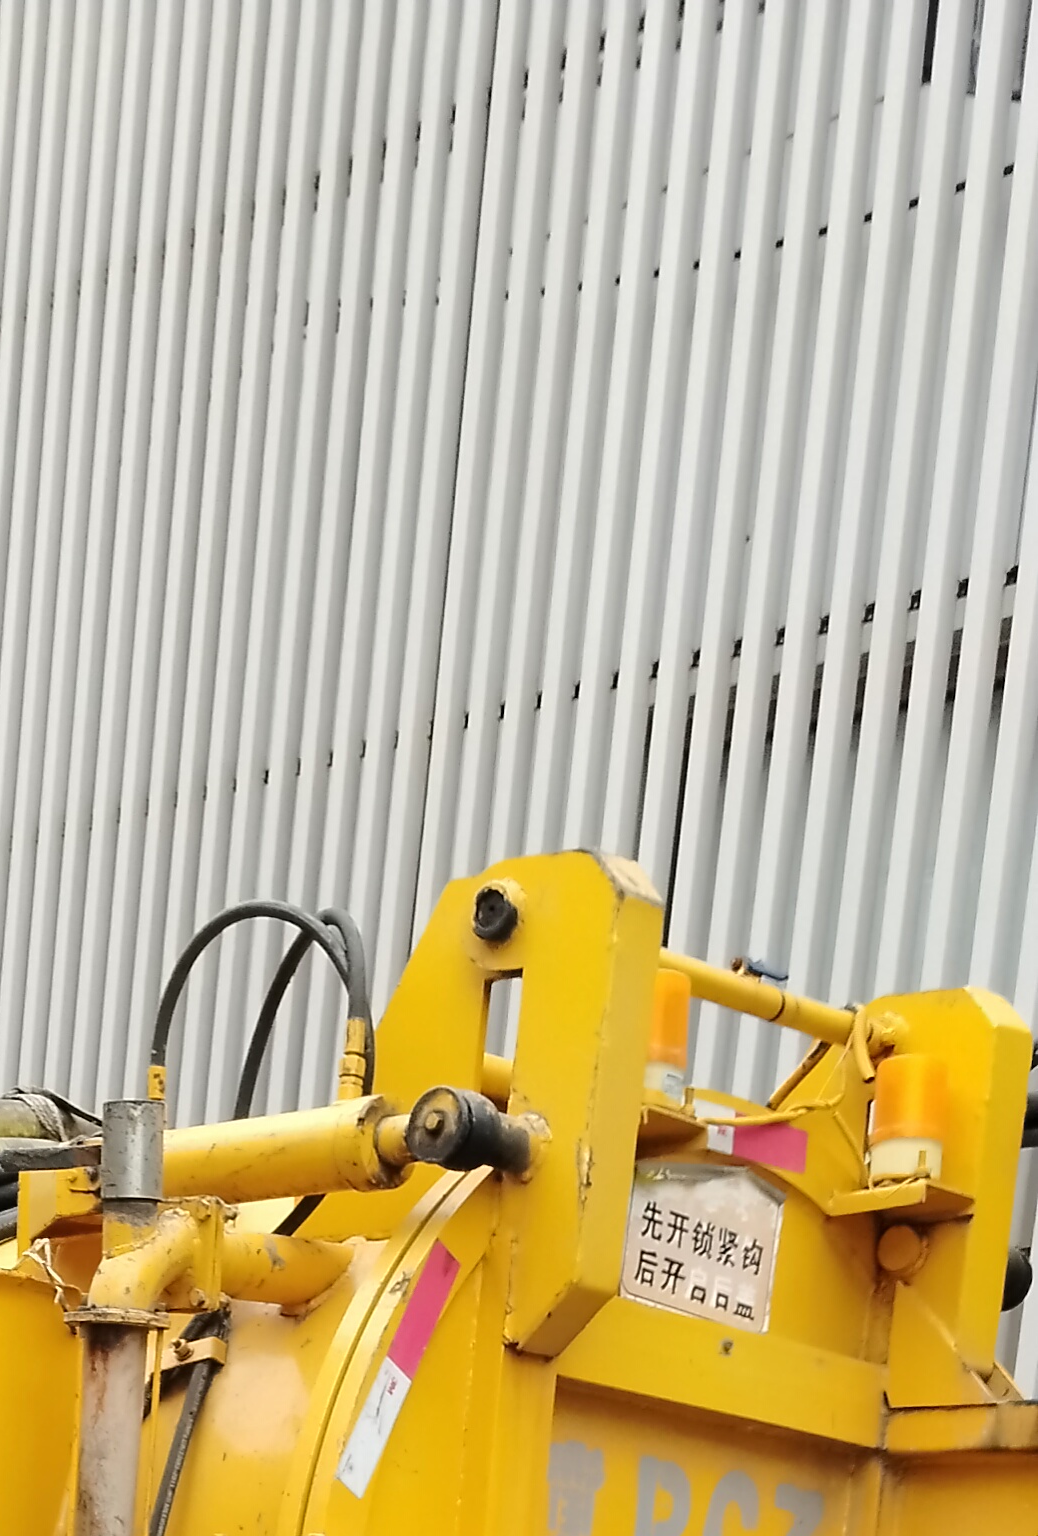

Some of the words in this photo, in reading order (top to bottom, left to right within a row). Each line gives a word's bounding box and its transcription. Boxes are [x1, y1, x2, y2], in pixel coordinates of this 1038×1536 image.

[641, 1200, 764, 1276] 先开锁紧钩
